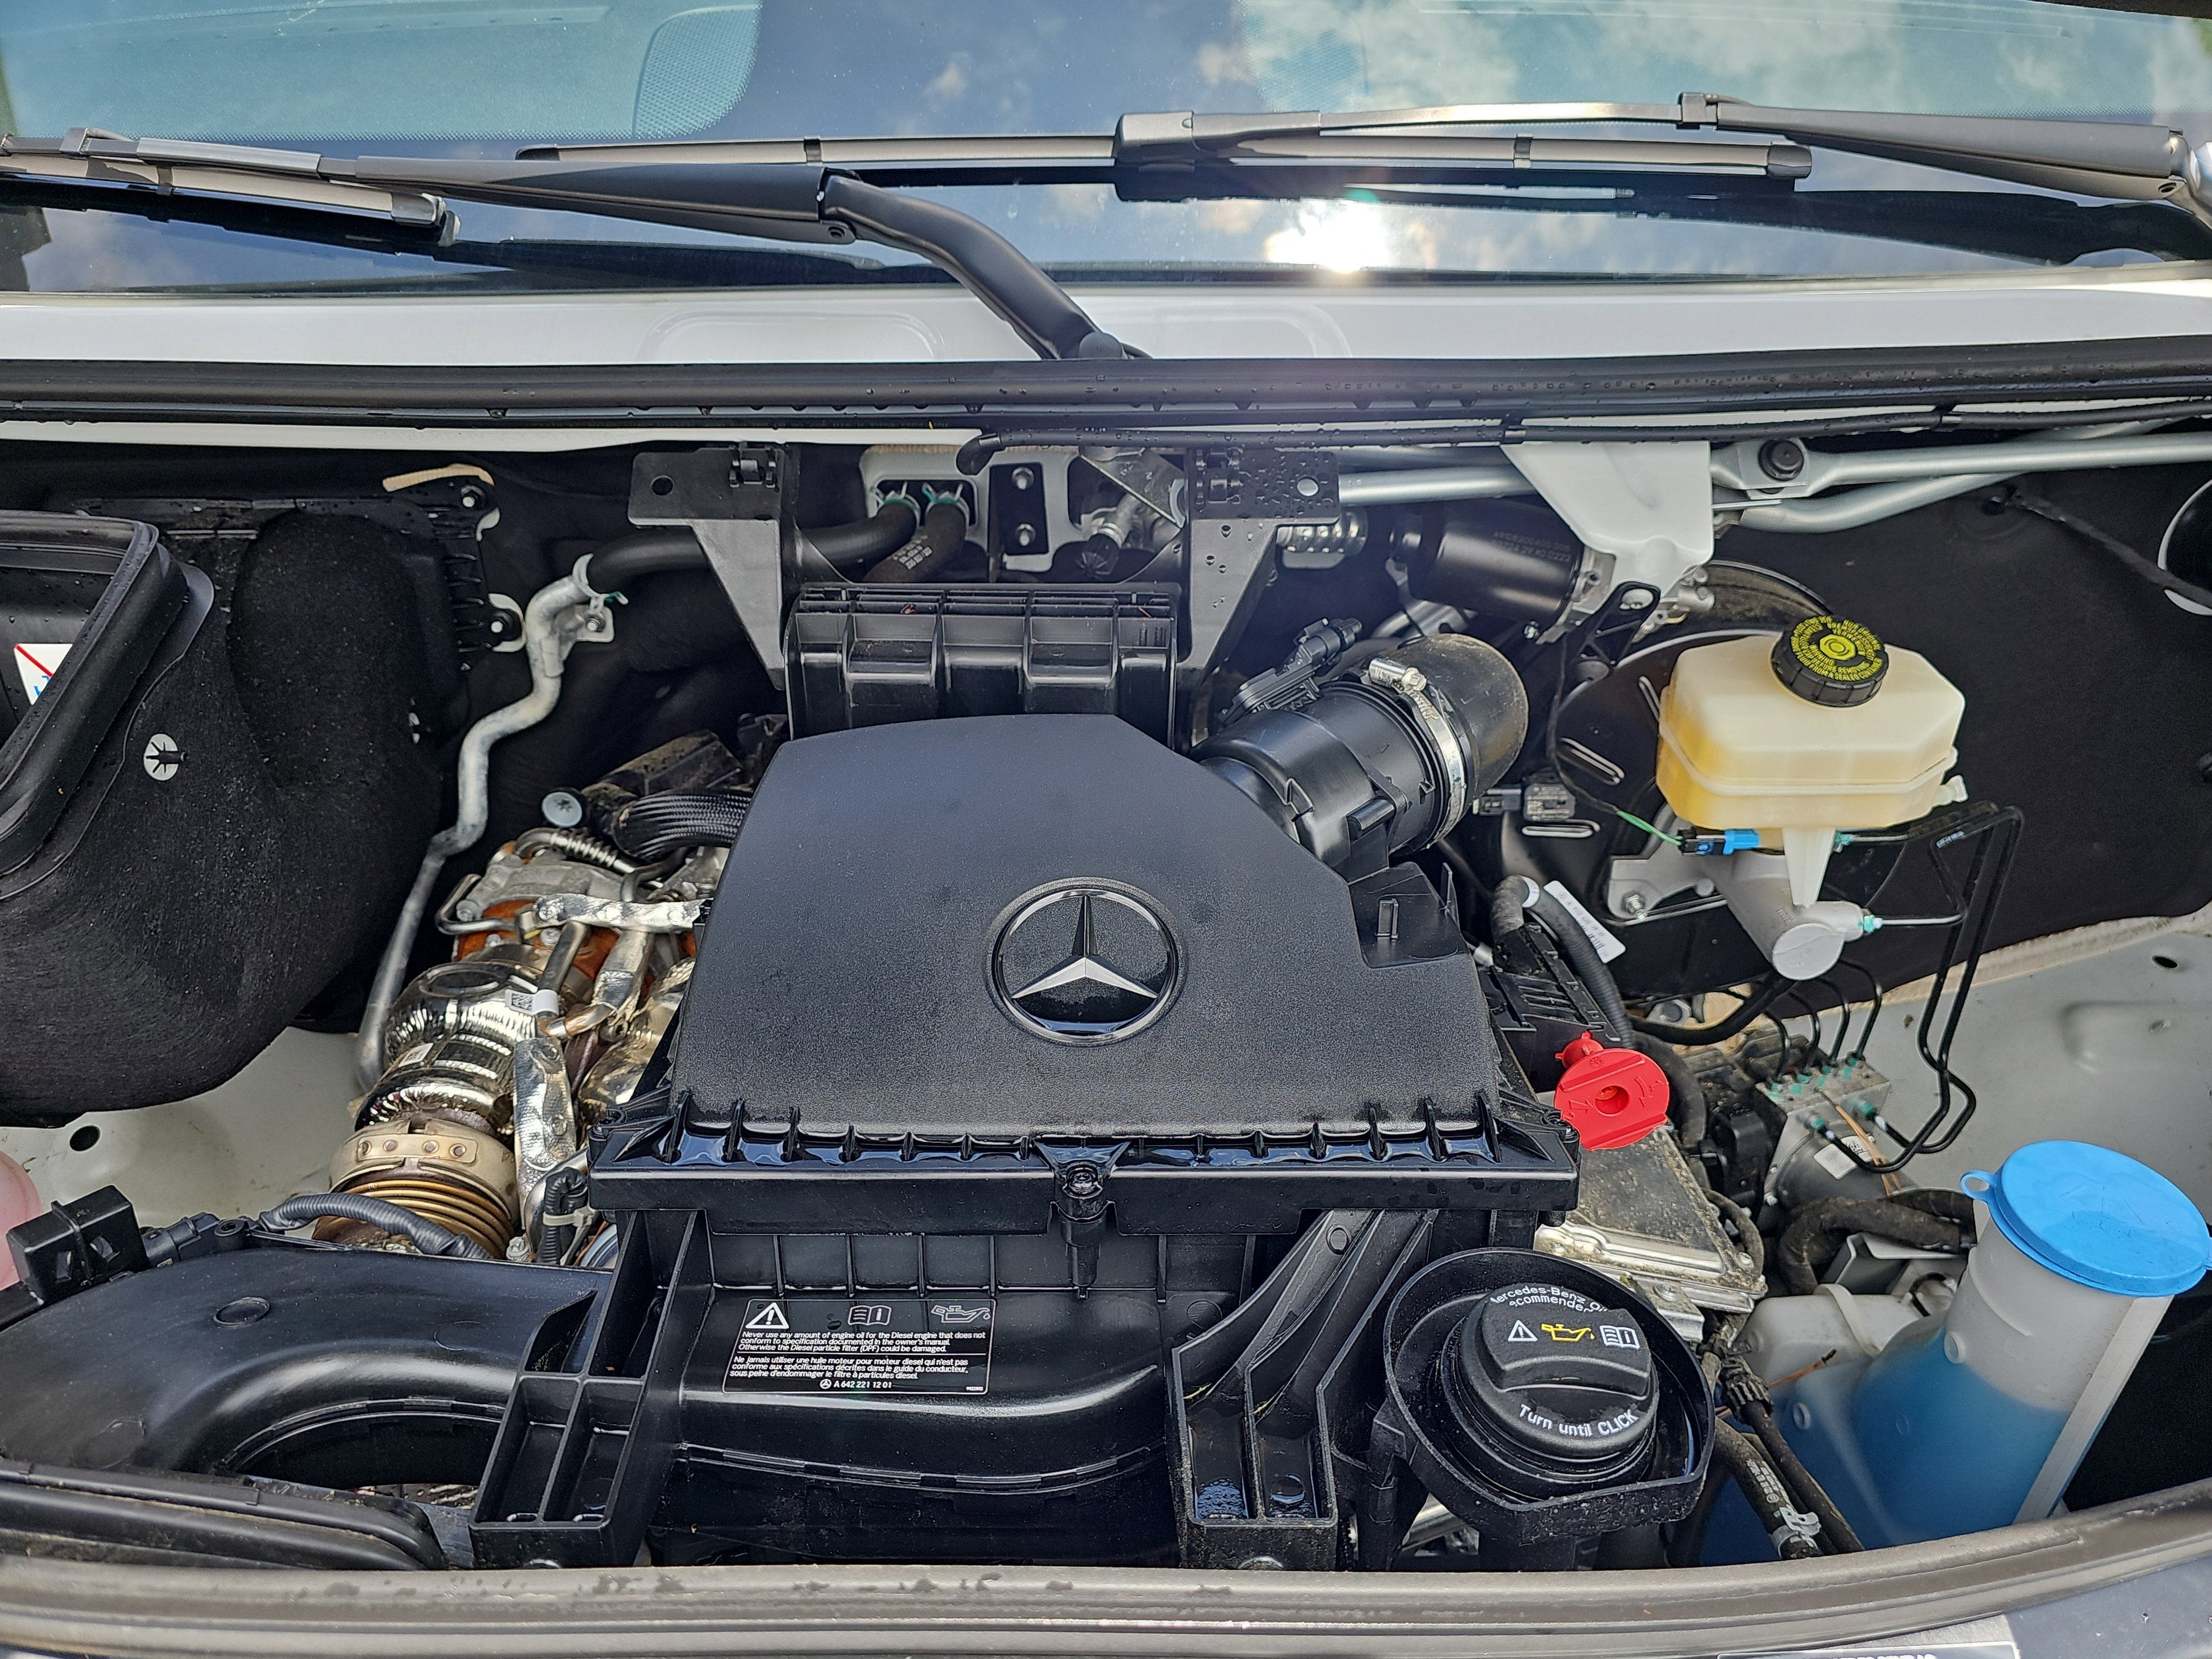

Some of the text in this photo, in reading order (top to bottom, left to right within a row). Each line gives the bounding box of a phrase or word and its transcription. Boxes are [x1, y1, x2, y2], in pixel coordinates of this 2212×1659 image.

[1509, 1295, 1593, 1313] ecommende
[1519, 1404, 1639, 1437] Turn until CLICK
